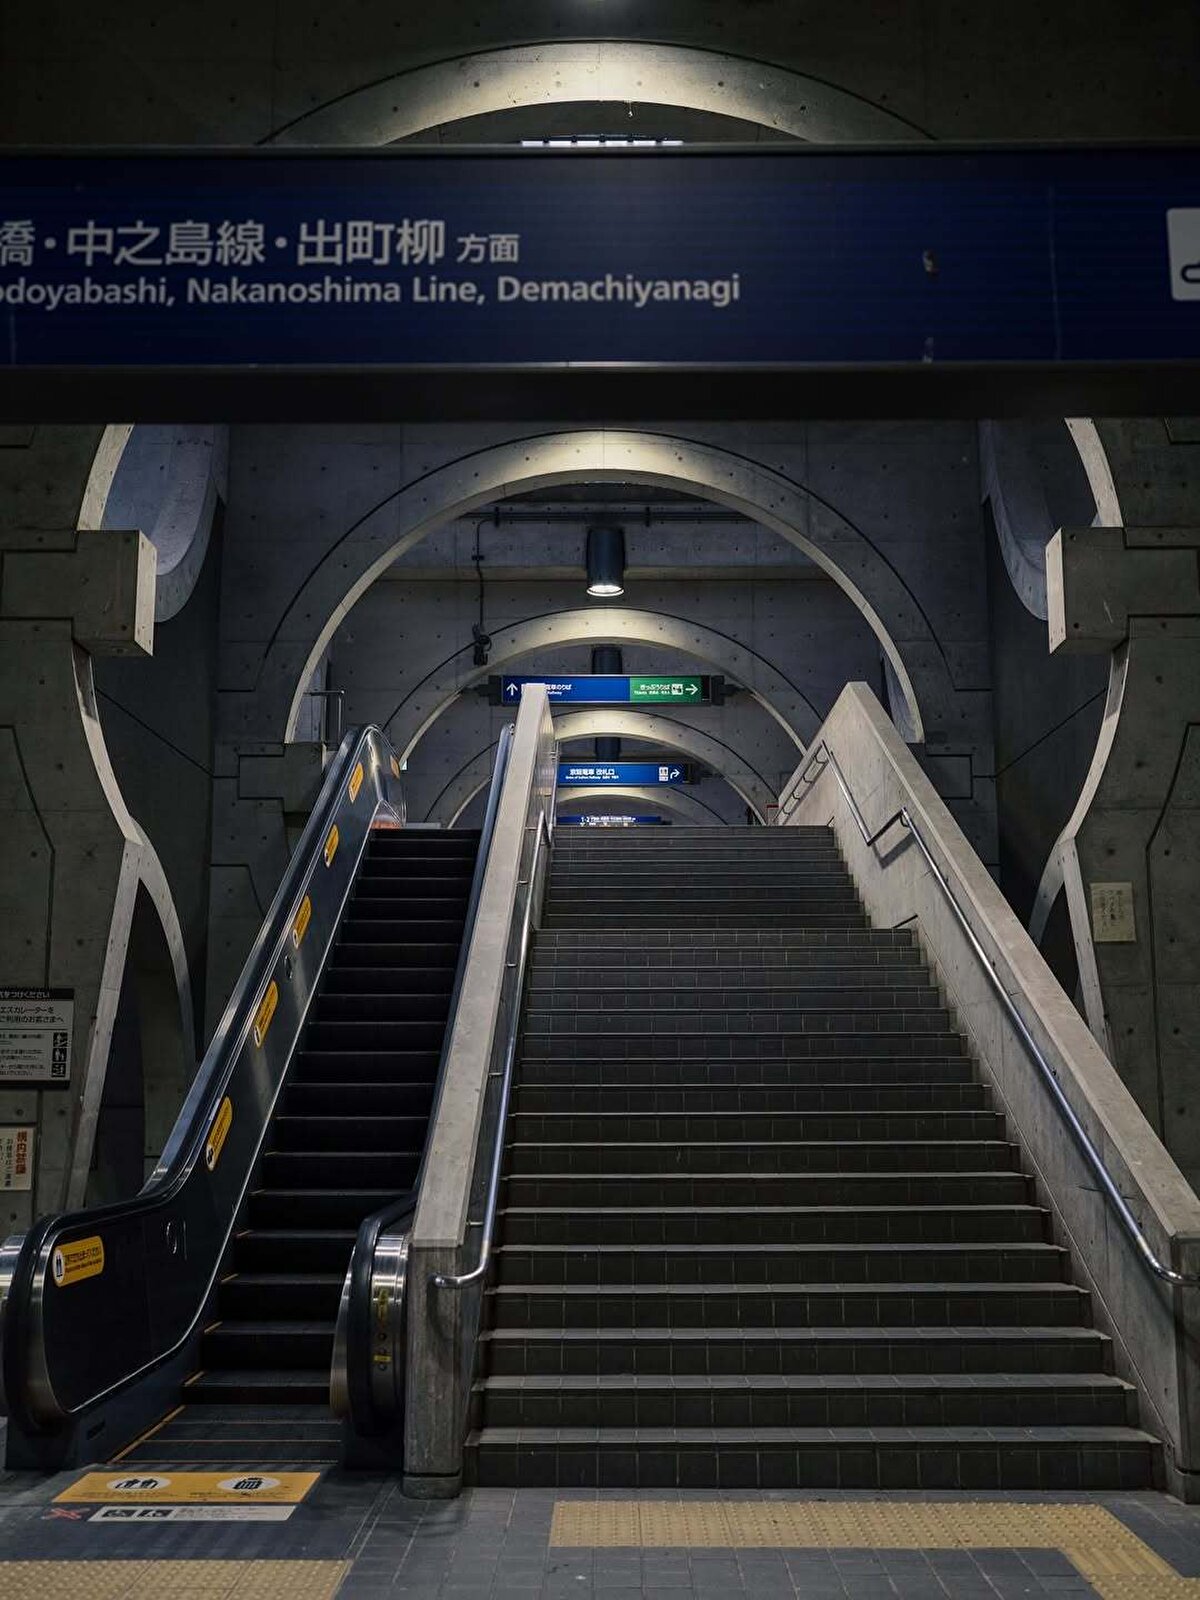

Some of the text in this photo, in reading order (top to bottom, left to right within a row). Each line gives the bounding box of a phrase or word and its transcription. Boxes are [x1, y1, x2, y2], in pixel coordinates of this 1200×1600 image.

[456, 233, 520, 264] 方面
[0, 273, 740, 311] doyabashi, Nakanoshima Line, Demachiyanagi
